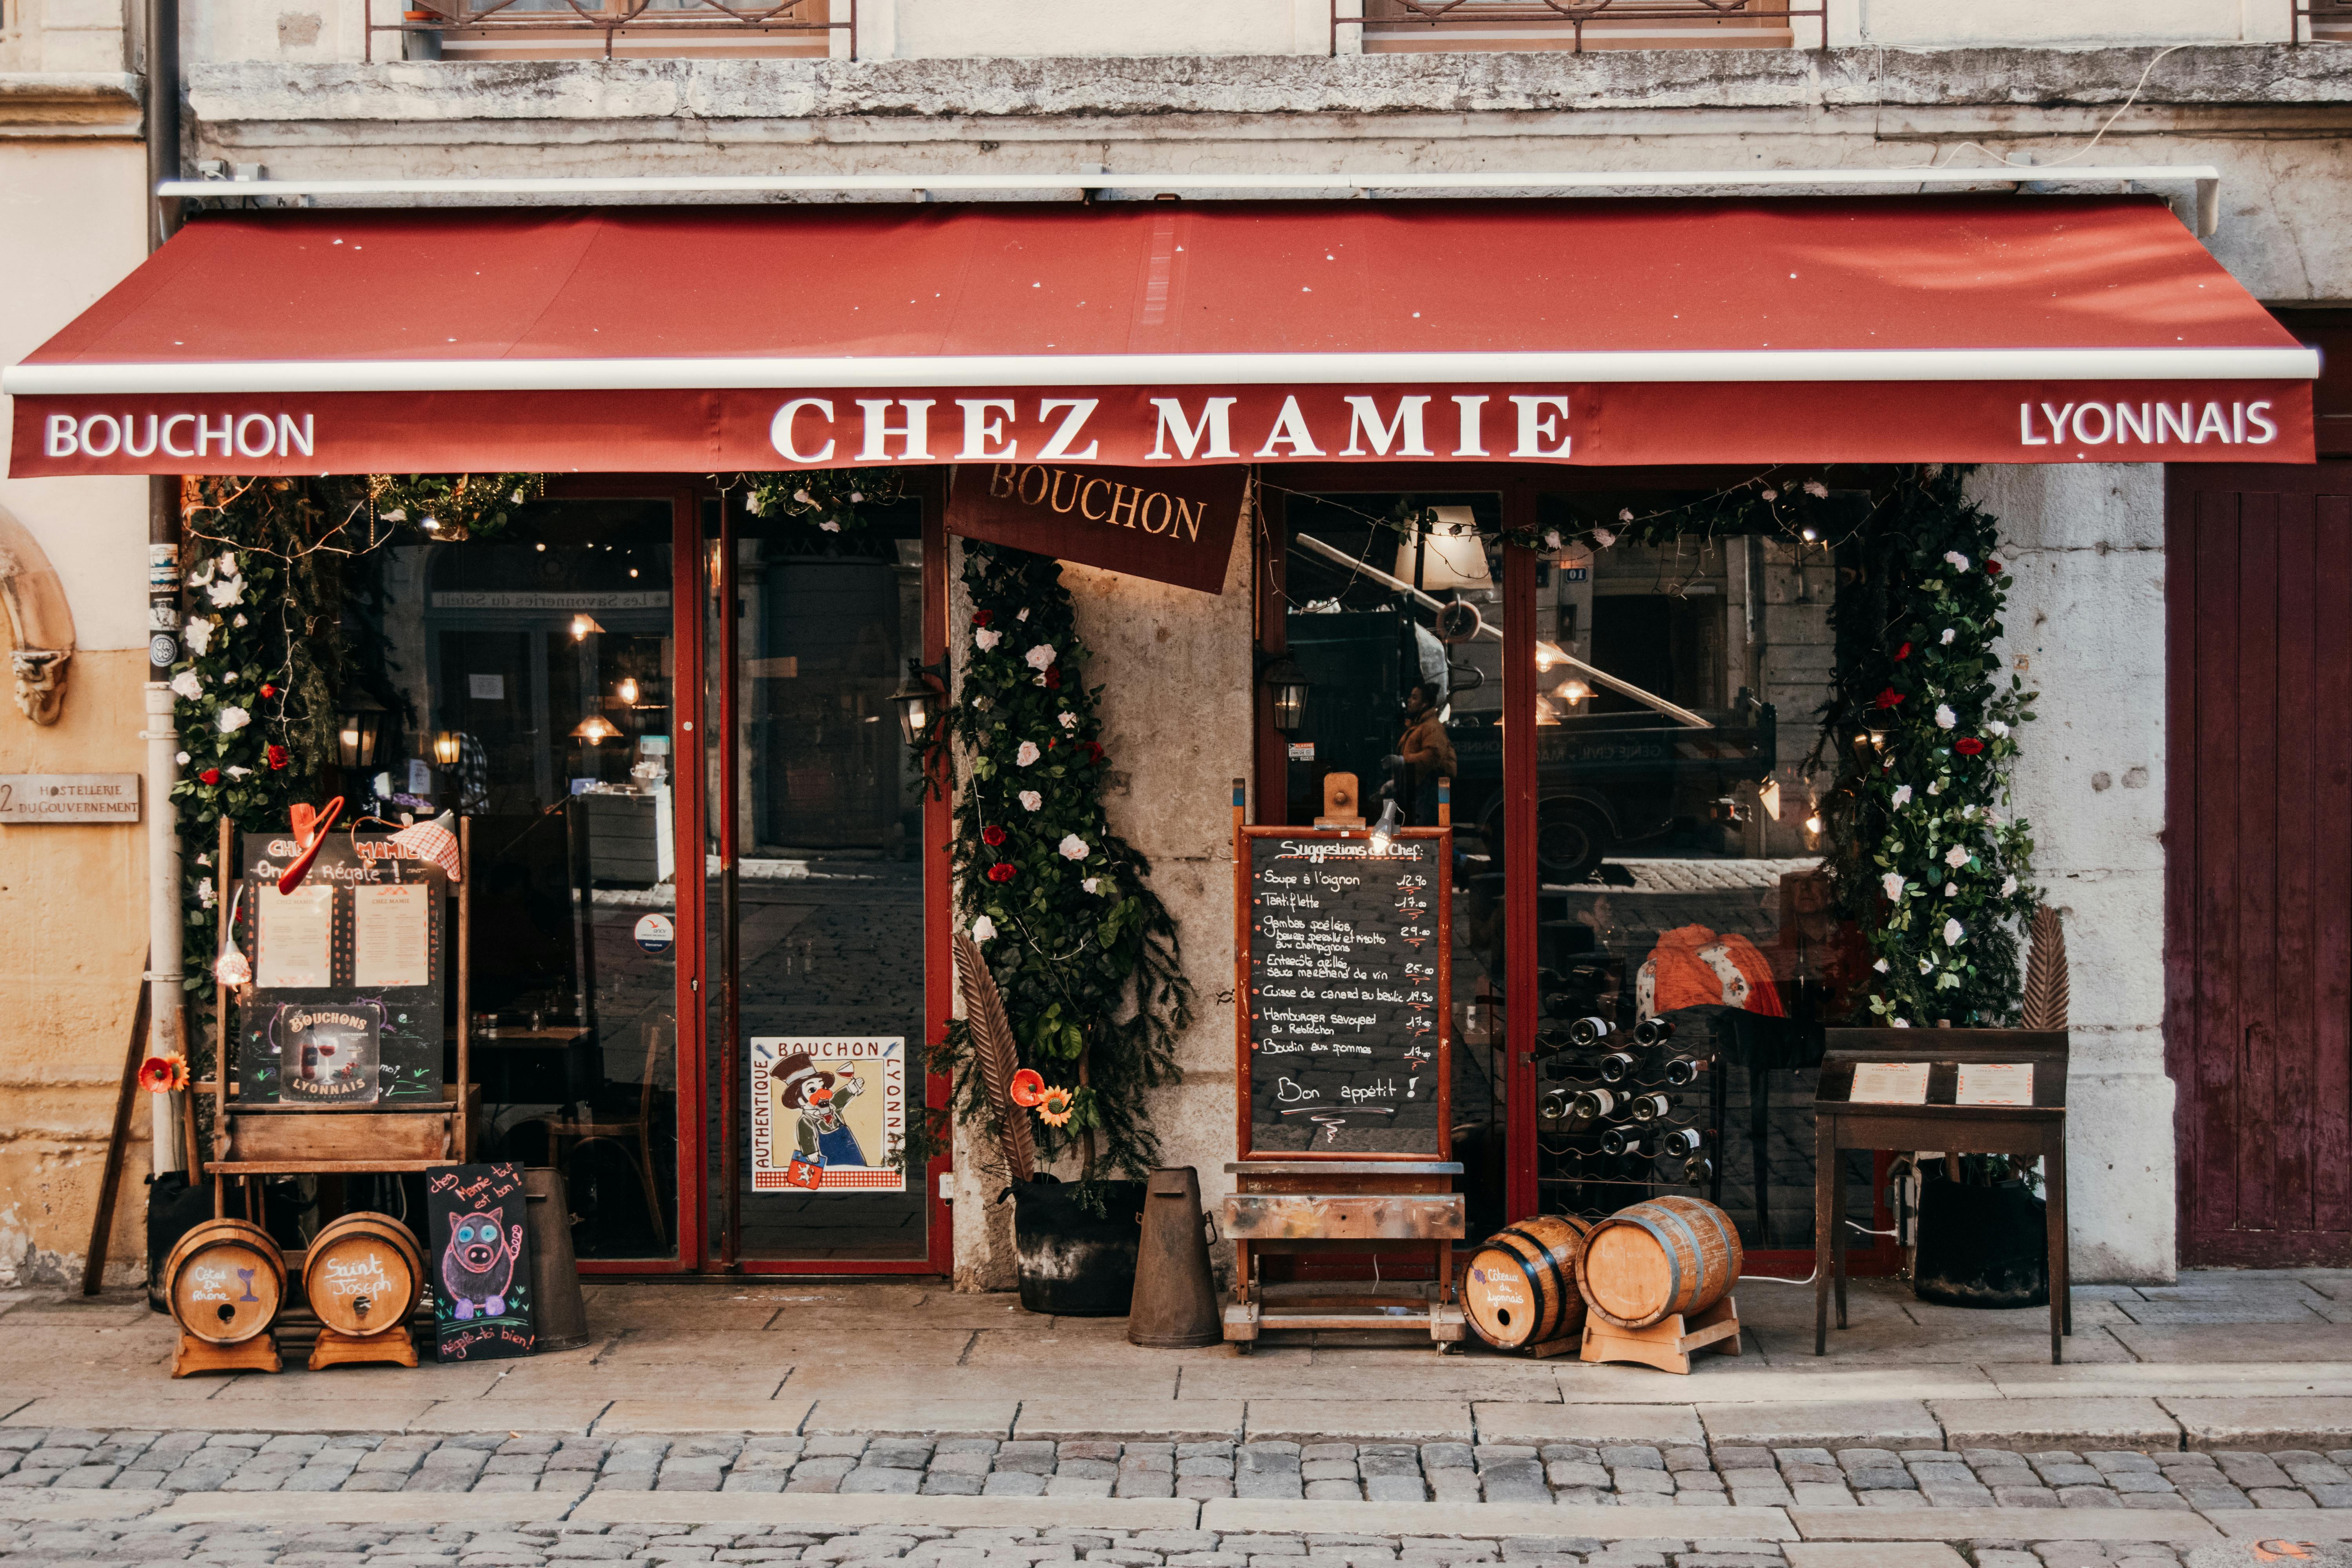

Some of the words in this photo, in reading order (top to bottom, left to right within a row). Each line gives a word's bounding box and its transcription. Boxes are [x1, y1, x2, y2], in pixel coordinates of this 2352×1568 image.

[770, 395, 1100, 463] CHEZ
[1144, 394, 1573, 461] MAMIE
[2020, 401, 2274, 445] LYONNAIS
[47, 413, 315, 458] BOUCHON
[989, 464, 1207, 543] BOUCHON
[40, 785, 122, 797] HSTELLERIE
[20, 803, 36, 813] DU
[40, 801, 138, 813] GOUVERNEMENT
[267, 840, 302, 857] CHE
[356, 841, 421, 860] MAMIE
[1275, 840, 1367, 863] Suggestions
[323, 861, 380, 889] Régale
[1264, 869, 1297, 889] Soupe
[1303, 873, 1310, 884] à
[1315, 871, 1360, 892] l'oignon
[1396, 875, 1427, 886] 12.90
[1261, 893, 1319, 913] Tartiflette
[1395, 897, 1427, 908] 17.00
[1343, 931, 1355, 943] et
[1356, 932, 1386, 944] risotto
[1401, 926, 1430, 936] 29.00
[1276, 940, 1292, 949] aux
[1296, 940, 1350, 956] champignons
[1267, 954, 1313, 967] Entrecôte
[1405, 963, 1434, 975] 25.00
[1354, 967, 1367, 980] de
[1372, 971, 1388, 980] vin
[1263, 985, 1296, 998] Cuisse
[1301, 986, 1316, 998] de
[1361, 991, 1374, 1000] au
[1377, 988, 1403, 1002] basilic
[1406, 991, 1433, 1002] 19.50
[289, 1012, 368, 1033] BOUCHONS
[1263, 1007, 1325, 1028] Hamburger
[1330, 1014, 1376, 1032] savoyard
[1272, 1024, 1282, 1033] au
[1289, 1024, 1335, 1035] Reblochon
[778, 1042, 879, 1057] BOUCHON
[1261, 1038, 1304, 1054] Boudin
[1311, 1043, 1328, 1051] aux
[1333, 1044, 1372, 1057] pommes
[292, 1078, 365, 1094] LYONNAIS
[1278, 1076, 1320, 1102] Bon
[1341, 1078, 1397, 1104] appétit
[1407, 1077, 1419, 1098] !
[755, 1060, 769, 1168] AUTHENTIQUE
[455, 1176, 492, 1201] Mamie
[491, 1162, 513, 1177] tout
[474, 1193, 491, 1209] est
[493, 1185, 514, 1198] bon
[195, 1266, 226, 1281] Côtes
[325, 1253, 383, 1278] Saint
[1487, 1267, 1519, 1283] Côteaux
[192, 1289, 230, 1301] Rhône
[330, 1273, 392, 1301] Joseph
[1499, 1282, 1513, 1292] du
[1487, 1289, 1524, 1307] Lyonnais
